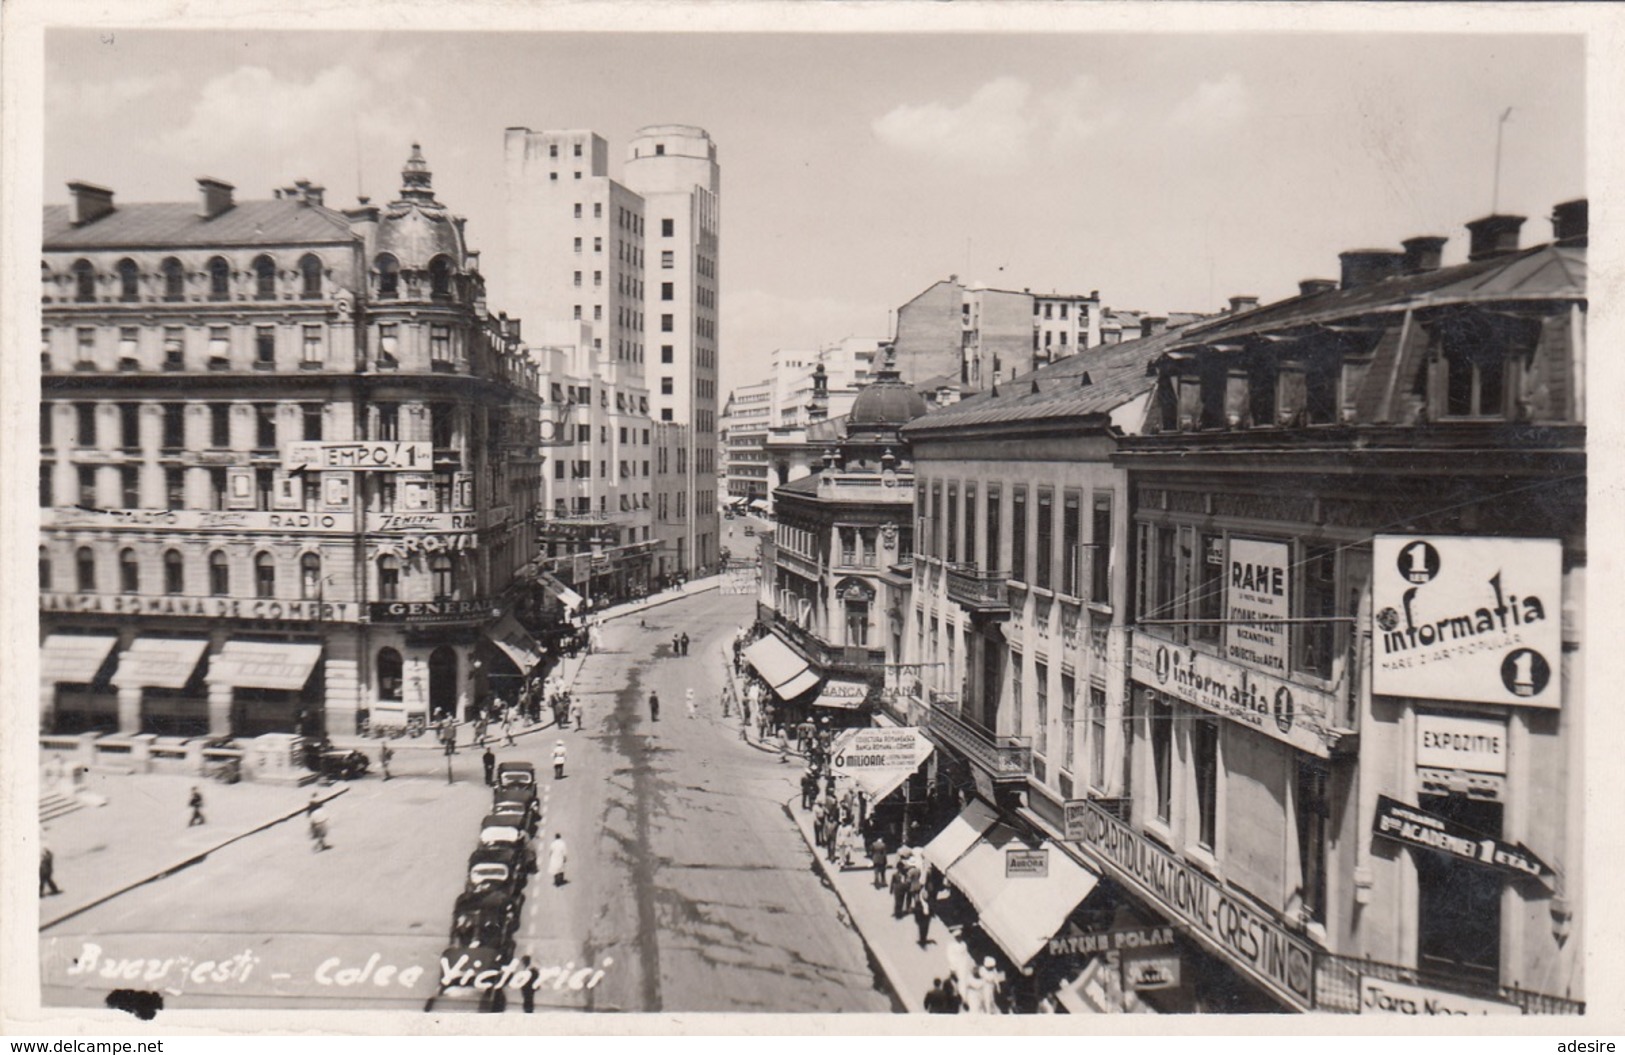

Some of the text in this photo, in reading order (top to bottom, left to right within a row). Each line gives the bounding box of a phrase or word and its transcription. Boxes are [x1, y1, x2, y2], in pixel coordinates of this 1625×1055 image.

[270, 515, 336, 528] RADIO
[1406, 543, 1429, 572] 1
[1232, 561, 1284, 597] RAME
[834, 747, 846, 768] 6
[1114, 927, 1175, 949] POLAR
